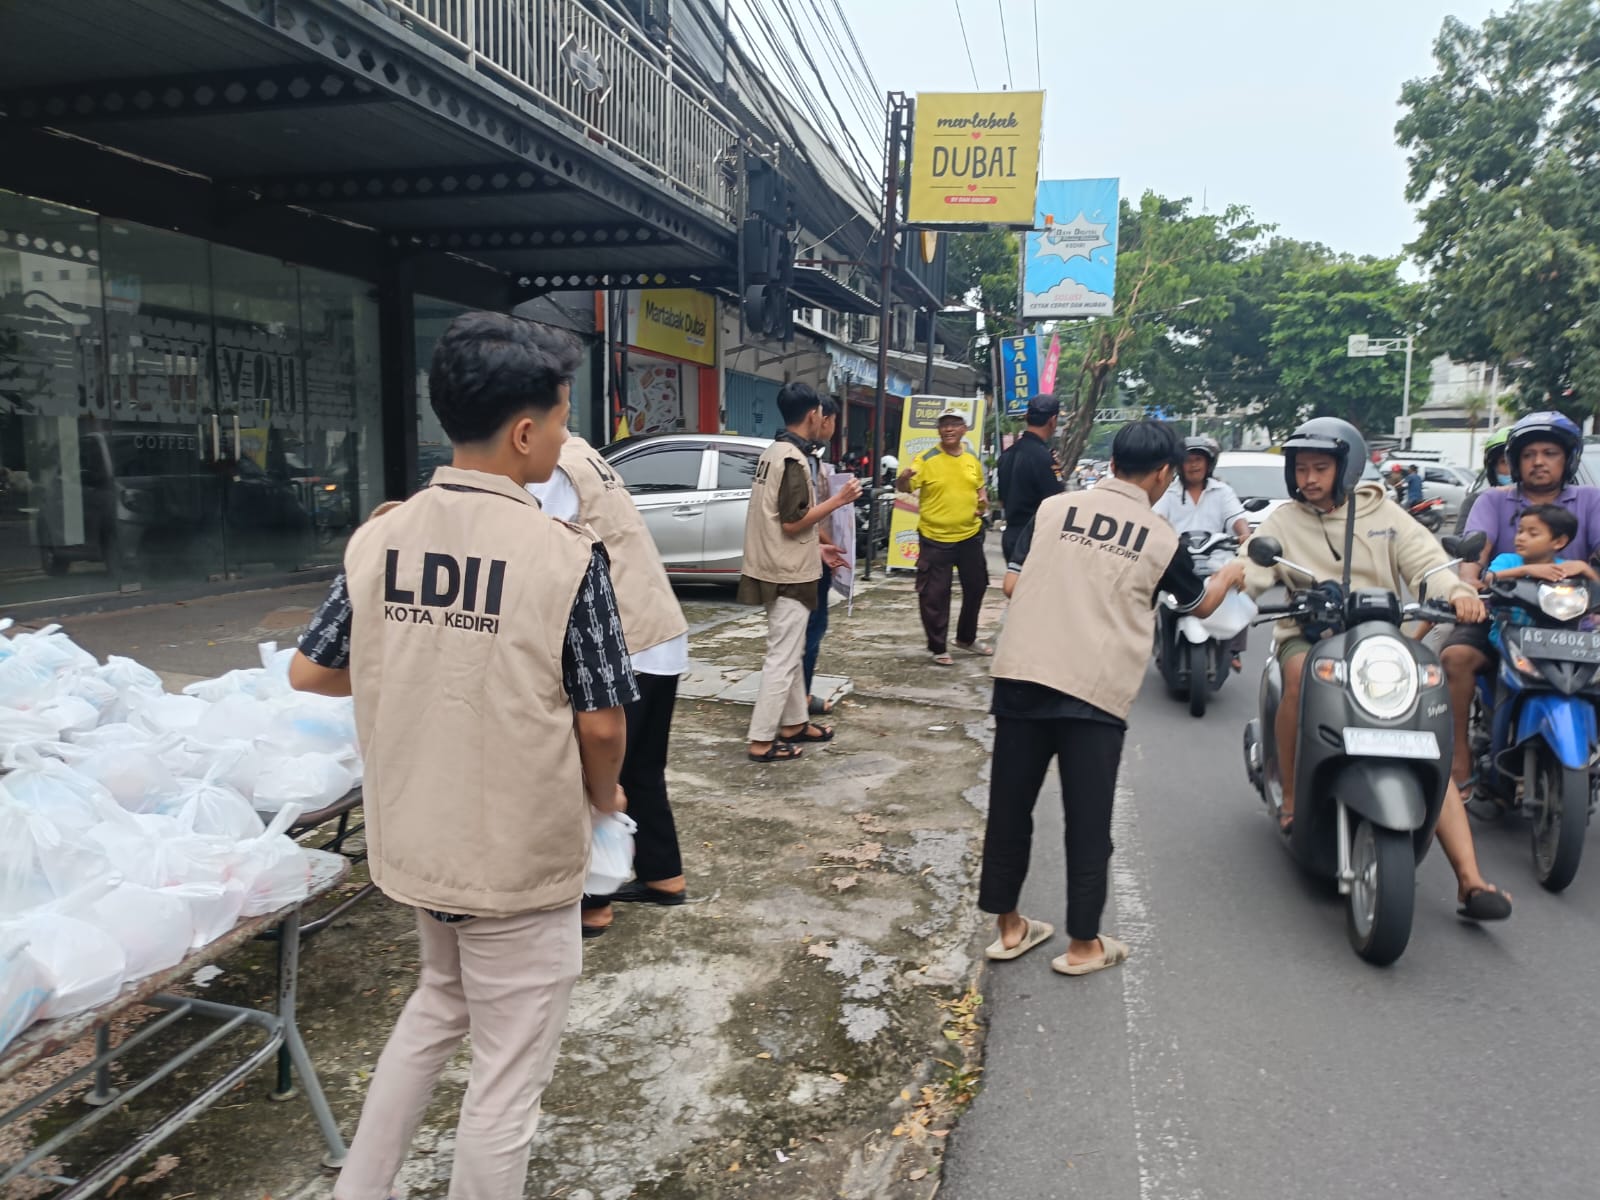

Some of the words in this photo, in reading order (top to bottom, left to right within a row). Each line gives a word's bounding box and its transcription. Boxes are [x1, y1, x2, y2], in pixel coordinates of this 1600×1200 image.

[937, 112, 1018, 129] martabak
[932, 146, 1017, 178] DUBAI
[646, 299, 684, 330] Martabak
[685, 313, 707, 336] Dubai
[1013, 338, 1029, 399] SALON
[133, 434, 195, 451] COFFEE
[1062, 506, 1150, 553] LDII
[1060, 532, 1093, 548] KOTA
[1099, 542, 1140, 562] KEDIRI
[384, 549, 507, 616] LDII
[384, 605, 434, 625] KOTA
[444, 611, 500, 634] KEDIRI
